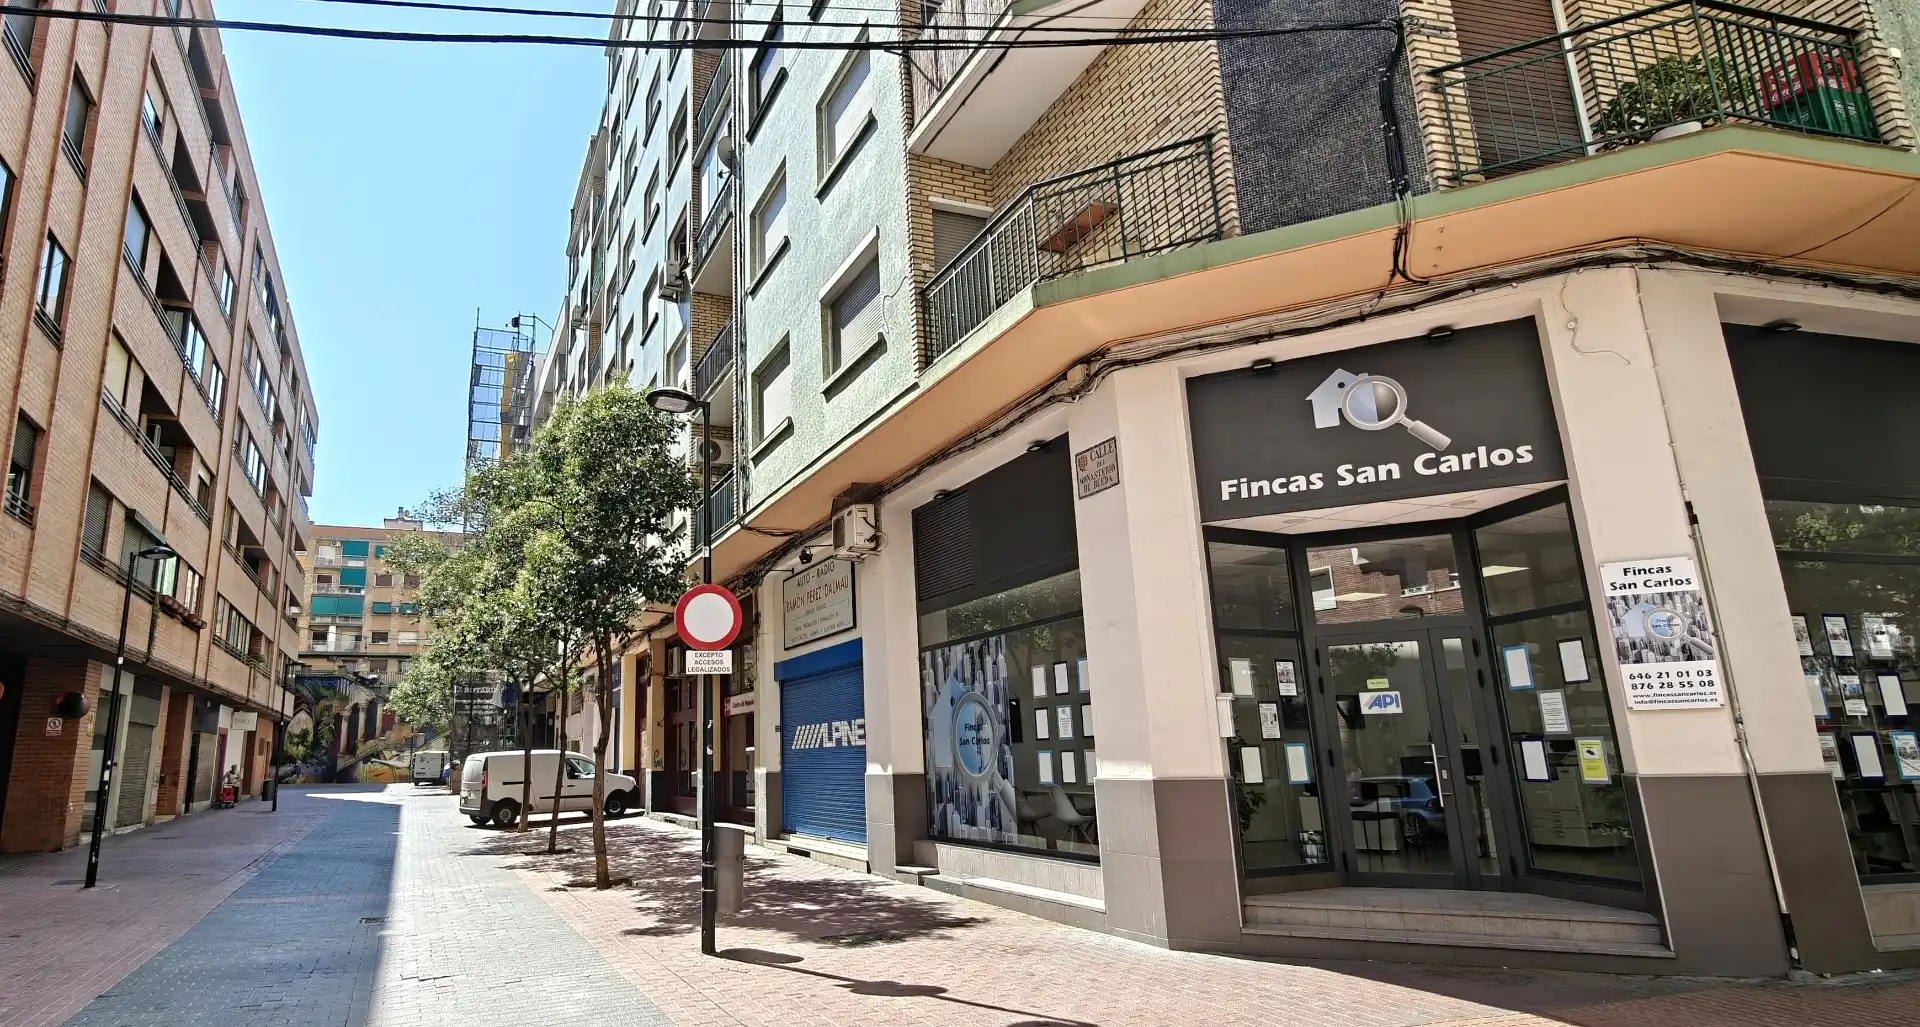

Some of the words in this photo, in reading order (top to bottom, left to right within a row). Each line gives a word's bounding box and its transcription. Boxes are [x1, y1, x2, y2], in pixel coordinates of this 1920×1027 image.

[1090, 442, 1114, 461] CALLE
[1080, 464, 1115, 484] MONASTERIO
[1220, 472, 1324, 501] Fincas
[1336, 461, 1401, 487] San
[1413, 445, 1534, 476] Carlos
[797, 573, 810, 588] AUTO
[817, 561, 834, 578] RADIO
[1622, 565, 1673, 577] Fincas
[1609, 581, 1638, 591] San
[1642, 577, 1692, 589] Carlos
[786, 593, 805, 613] RAMÓN
[806, 586, 822, 605] PÉREZ
[824, 574, 848, 597] DALMAU
[1629, 672, 1652, 680] 646
[1656, 671, 1670, 679] 21
[1676, 670, 1690, 678] 01
[1696, 669, 1712, 677] 03
[1630, 682, 1654, 691] 876
[1658, 681, 1674, 689] 28
[1678, 680, 1694, 689] 55
[1698, 679, 1715, 688] 08
[1368, 694, 1400, 709] API
[792, 718, 866, 749] ALPINE
[964, 723, 983, 732] Fincas
[959, 737, 970, 746] San
[971, 736, 991, 746] Carlos
